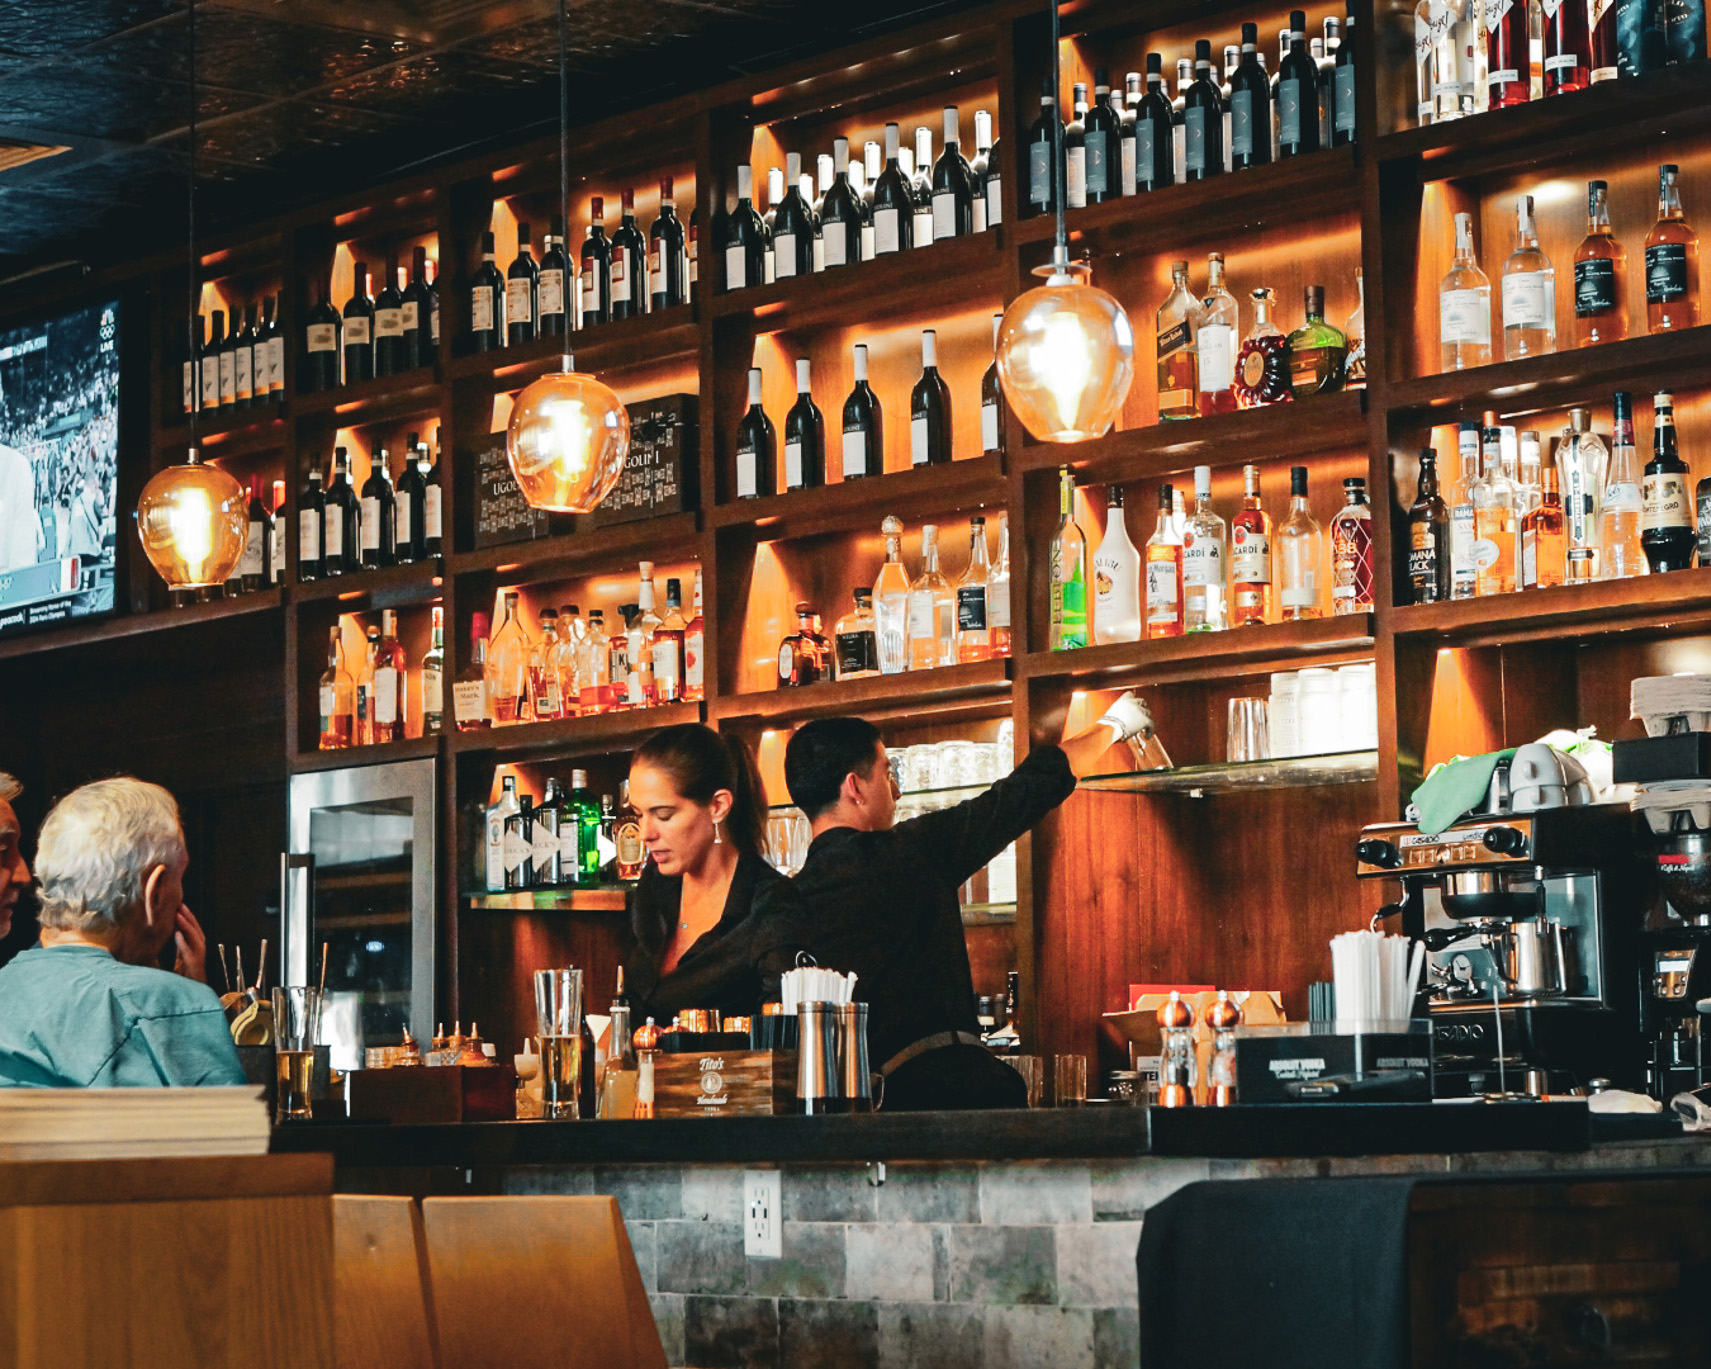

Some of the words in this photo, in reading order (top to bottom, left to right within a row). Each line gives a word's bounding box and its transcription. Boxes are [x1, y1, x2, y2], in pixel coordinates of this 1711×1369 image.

[100, 340, 114, 353] LIVE
[624, 450, 659, 468] GOLINI
[493, 481, 517, 496] UGOL
[698, 1056, 725, 1071] Tito's
